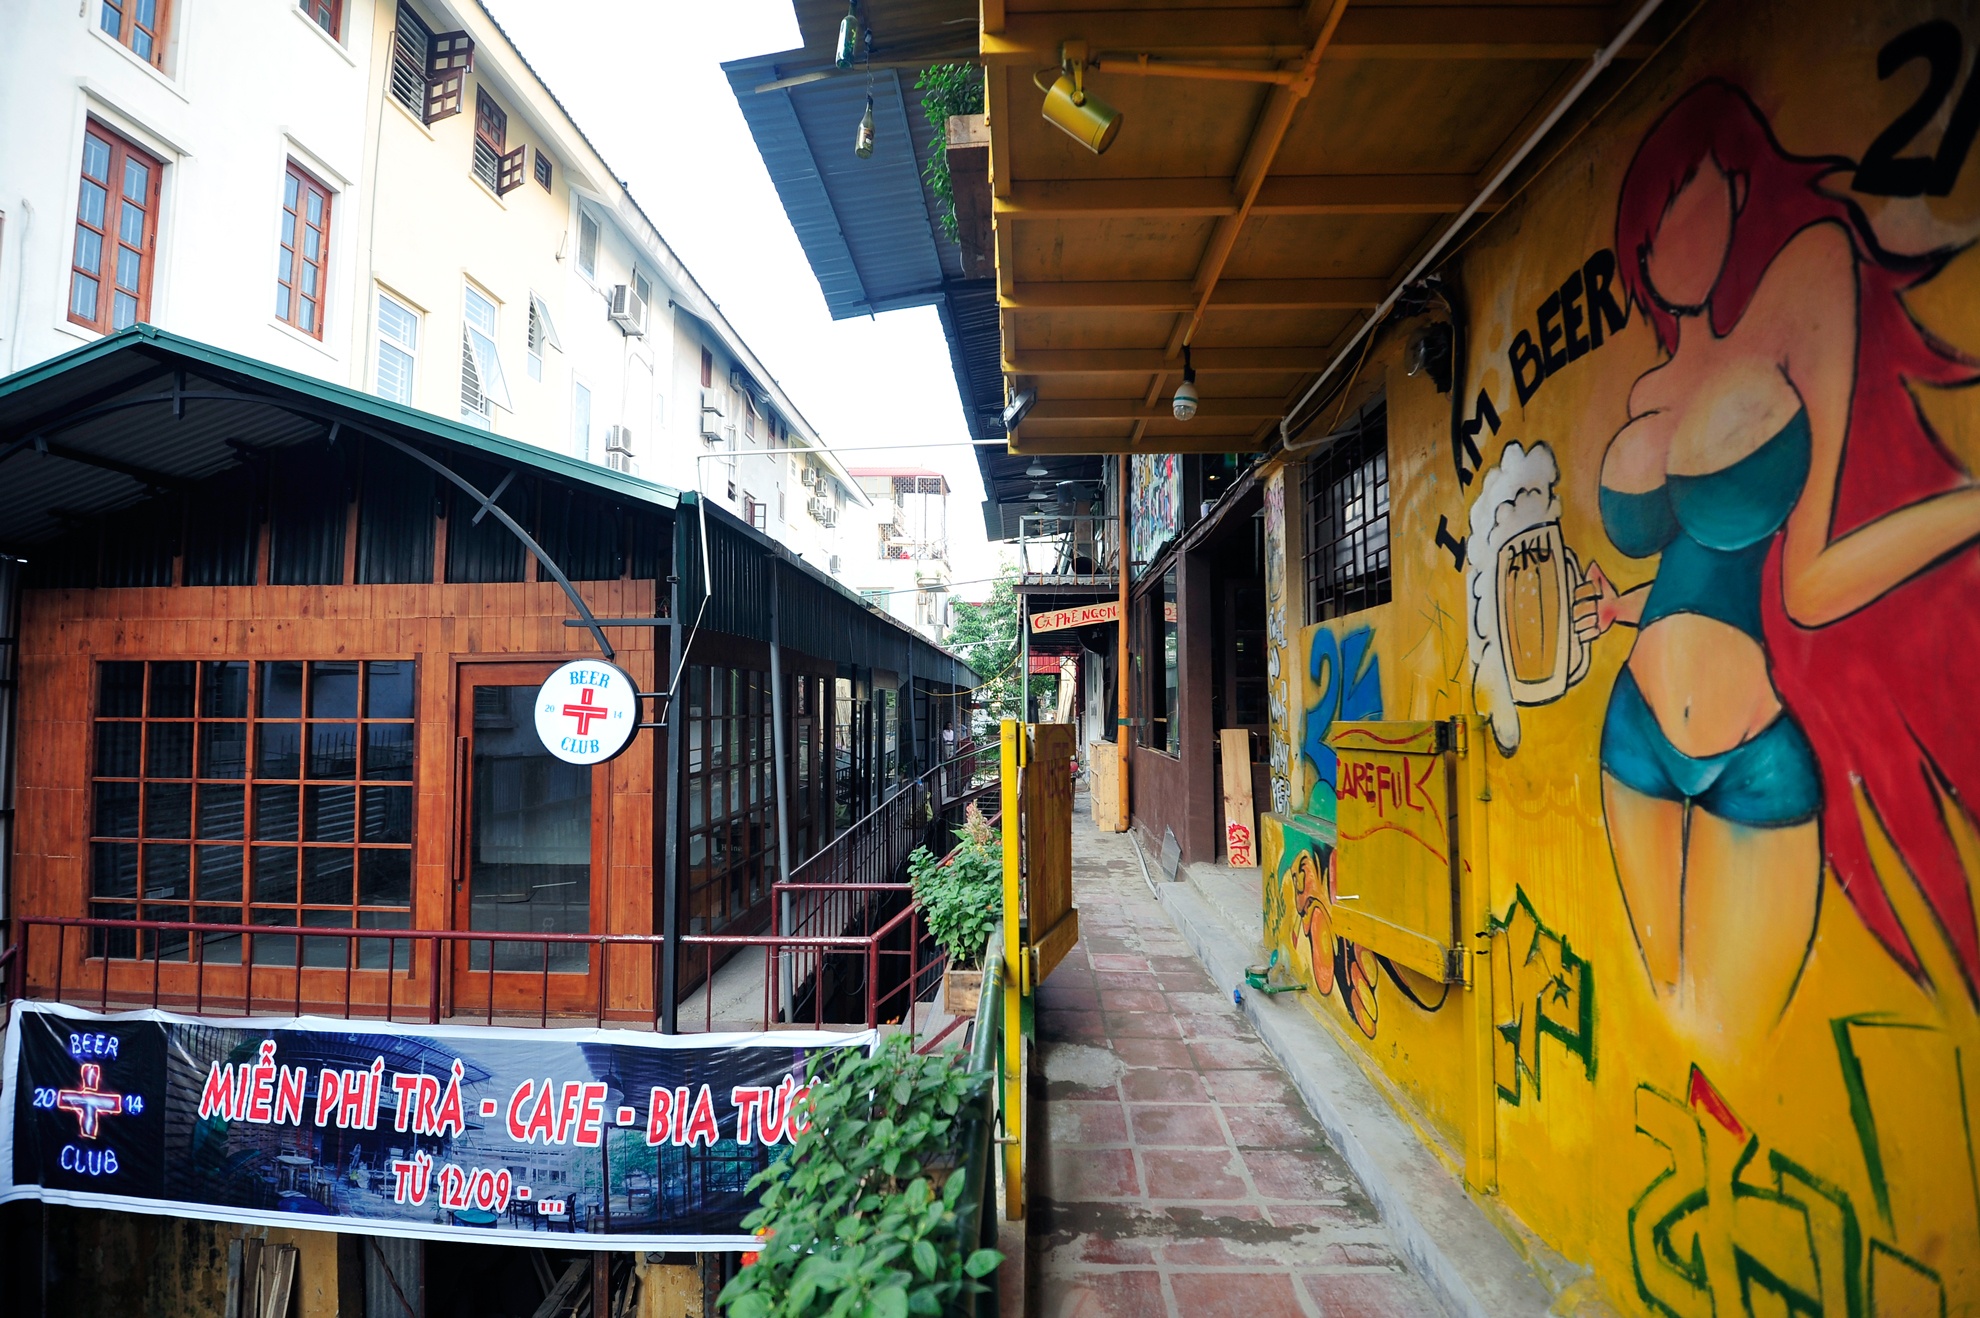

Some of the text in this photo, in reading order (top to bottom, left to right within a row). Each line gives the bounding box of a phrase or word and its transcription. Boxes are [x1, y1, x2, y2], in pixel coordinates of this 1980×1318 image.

[1508, 248, 1626, 408] BEER
[1081, 605, 1116, 621] NGON
[569, 670, 610, 688] BEER
[545, 704, 622, 719] 20 14
[561, 736, 599, 754] CLUB
[70, 1033, 119, 1057] BEER
[33, 1088, 143, 1113] 20 14
[199, 1040, 307, 1126] MIỄN
[315, 1056, 384, 1130] PHÍ
[394, 1059, 465, 1137] TRÀ
[506, 1078, 607, 1146] CAFE
[647, 1084, 718, 1147] BIA
[732, 1074, 829, 1146] TƯƠ
[61, 1145, 119, 1176] CLUB
[393, 1151, 433, 1205] TỪ
[438, 1164, 511, 1212] 12/09
